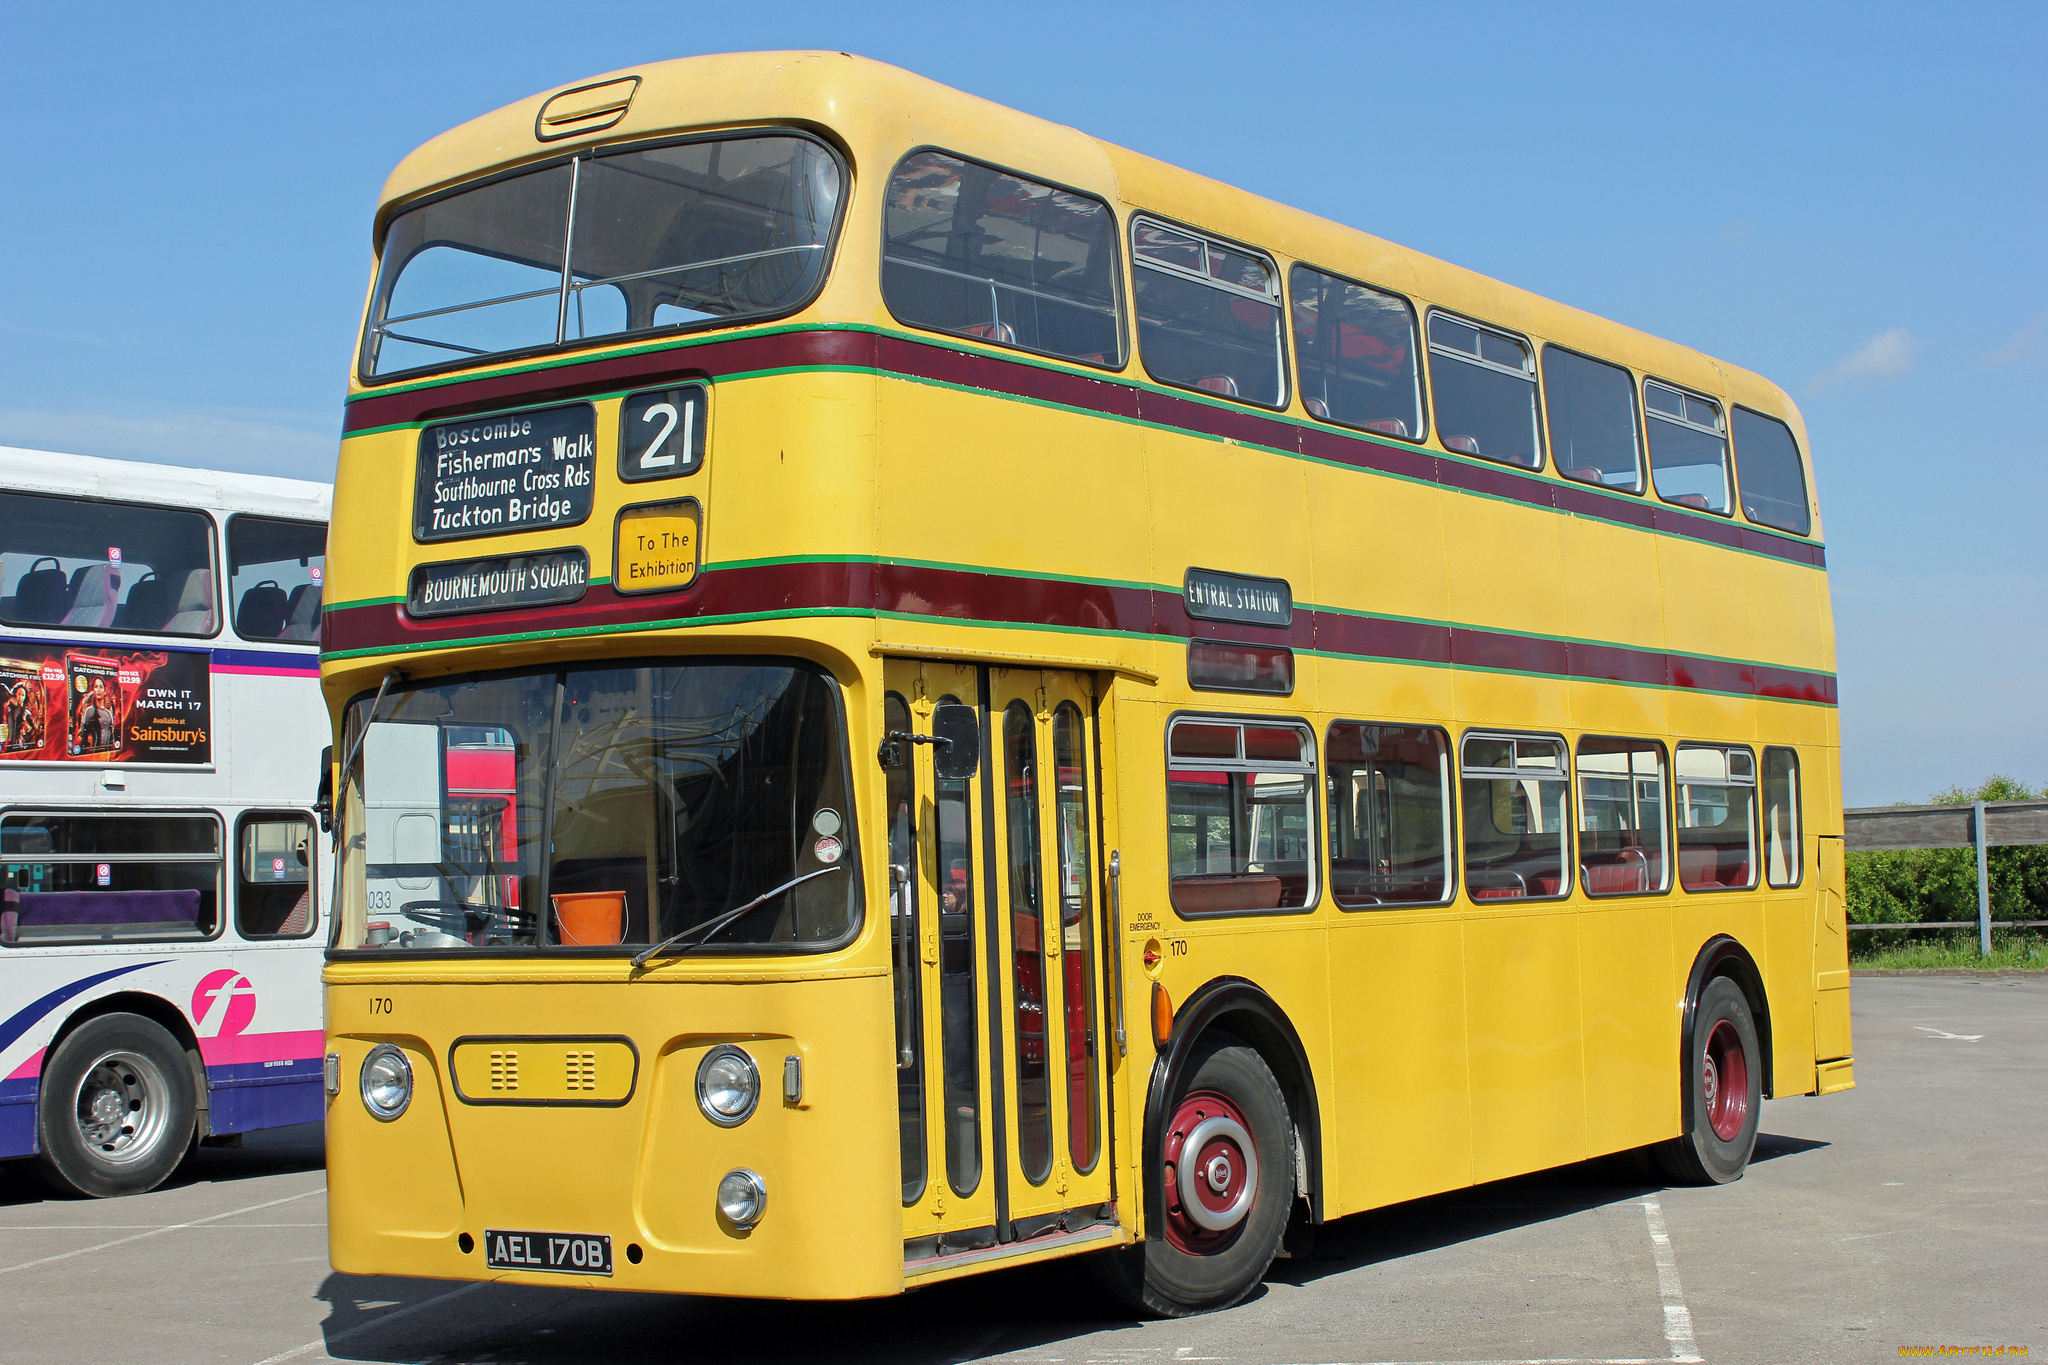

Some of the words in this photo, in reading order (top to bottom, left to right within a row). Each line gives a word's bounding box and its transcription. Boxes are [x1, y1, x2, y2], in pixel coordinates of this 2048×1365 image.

[436, 417, 532, 449] Boscombe
[640, 400, 695, 469] 21
[437, 446, 542, 478] Fisherman's
[552, 433, 593, 461] Walk
[434, 476, 517, 504] Southbourne
[523, 469, 560, 492] Cross
[564, 463, 591, 488] Rds
[432, 505, 502, 530] Tuckton
[509, 494, 572, 522] Bridge
[637, 535, 655, 551] To
[662, 532, 689, 549] The
[630, 558, 694, 579] Exhibition
[424, 567, 527, 604] BOURNEMOUTH
[530, 560, 586, 590] SQUARE
[1188, 580, 1233, 608] ENTRAL
[1236, 588, 1279, 613] STATION
[42, 673, 65, 681] £12.99
[73, 666, 106, 676] CATCHING
[119, 676, 141, 684] £12.99
[147, 688, 177, 698] OWN
[181, 690, 192, 699] IT
[136, 700, 183, 710] MARCH
[188, 702, 202, 711] 17
[153, 717, 179, 725] Available
[130, 726, 206, 745] Sainsbury's
[1129, 922, 1160, 931] EMERGENCY
[1137, 913, 1152, 921] DOOR
[1171, 940, 1187, 956] 170
[369, 997, 393, 1015] 170
[494, 1235, 541, 1264] AEL
[548, 1238, 604, 1268] 170B
